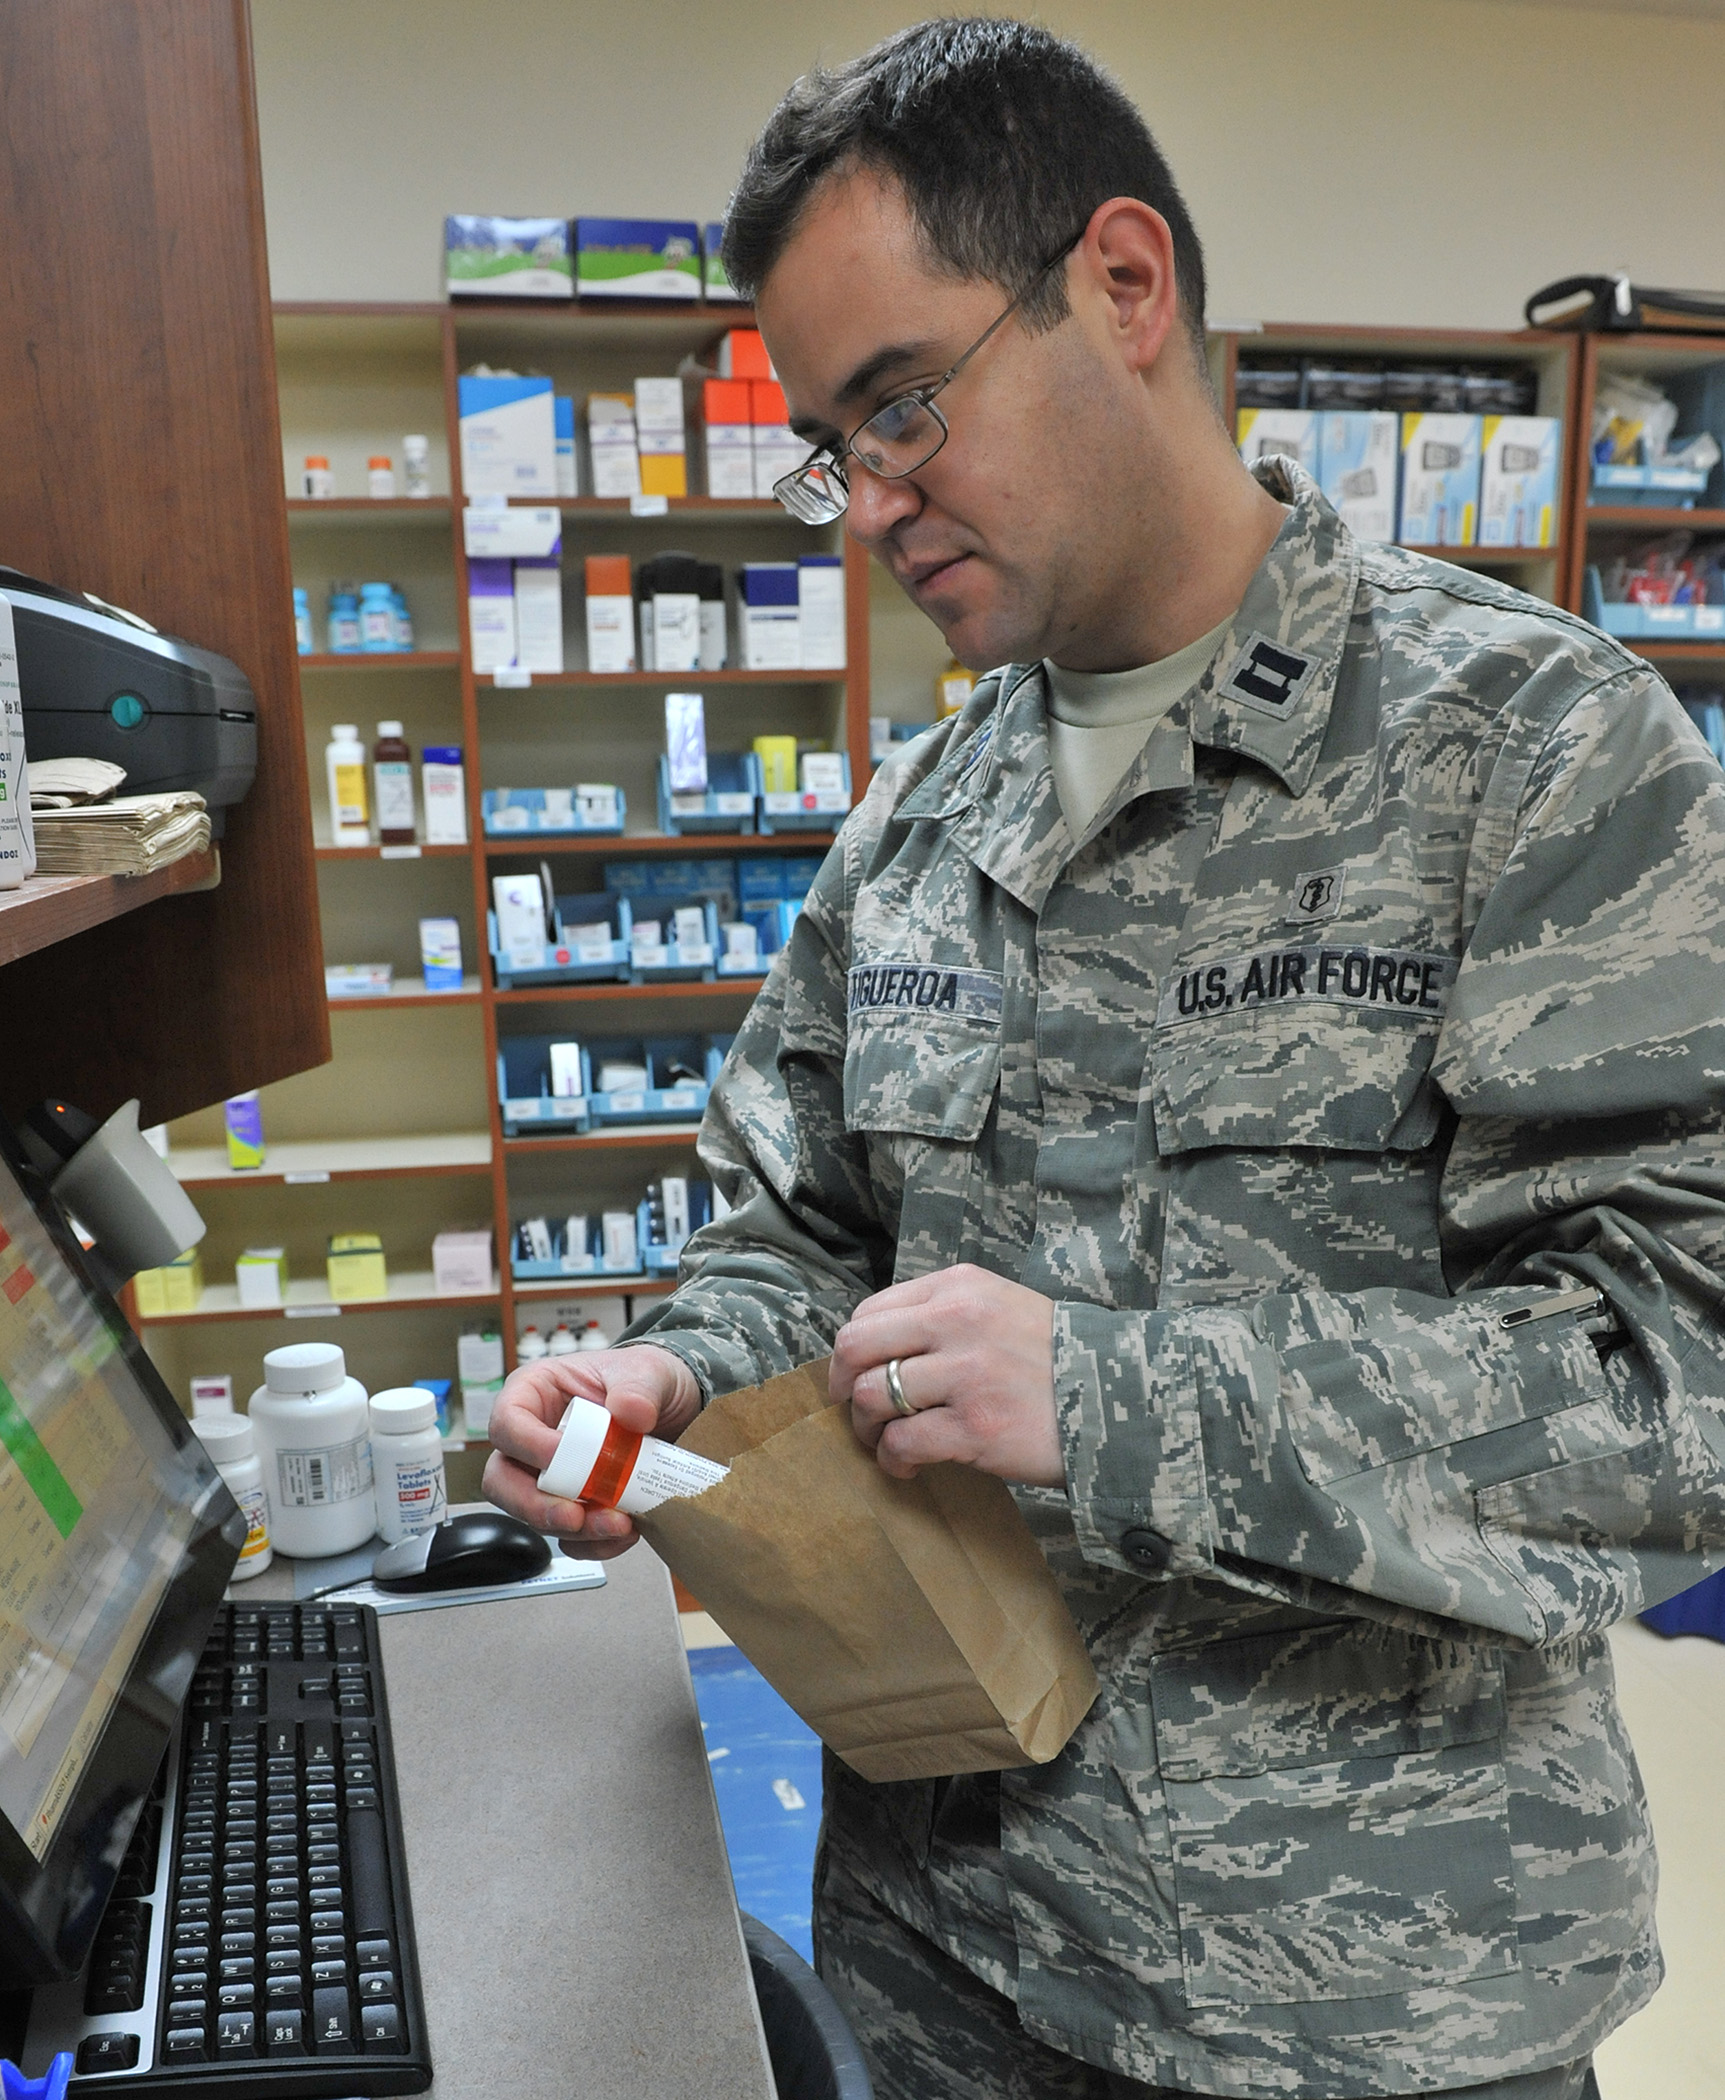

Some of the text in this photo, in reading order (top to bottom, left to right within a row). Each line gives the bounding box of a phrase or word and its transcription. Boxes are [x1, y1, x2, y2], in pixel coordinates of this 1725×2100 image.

[1178, 951, 1445, 1015] U.S. AIR FORCE
[398, 1480, 431, 1490] Tablets
